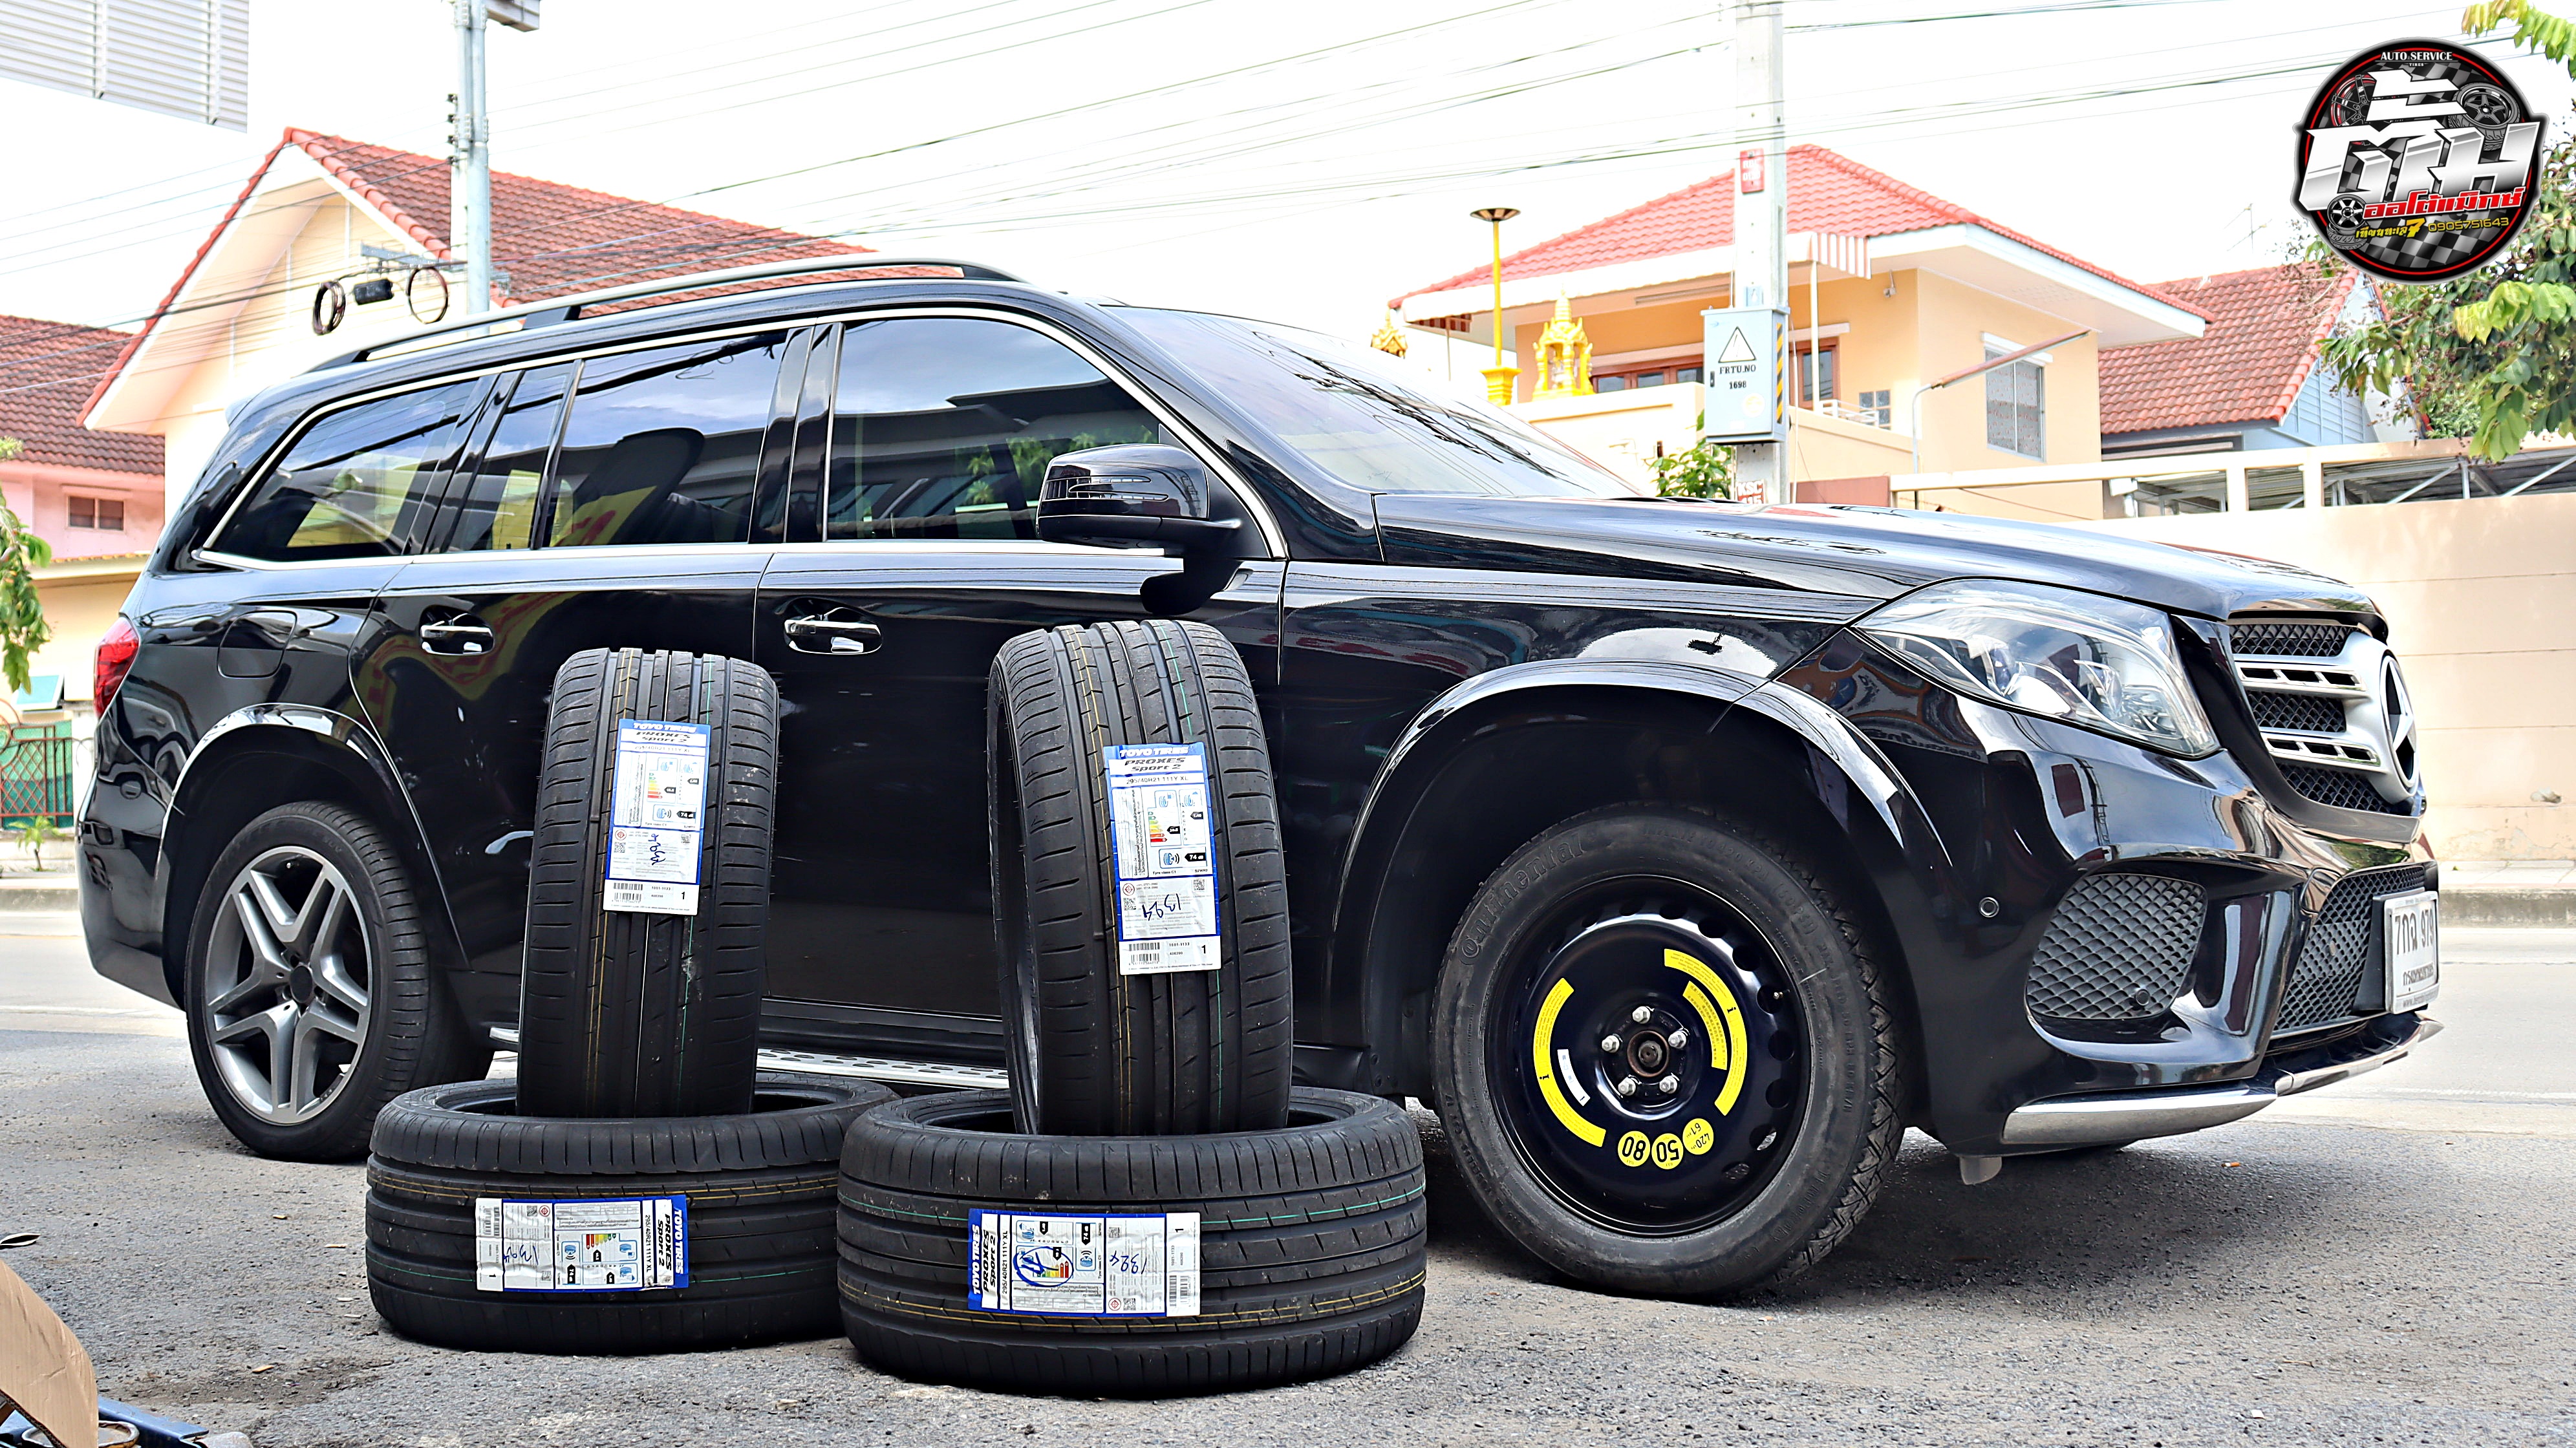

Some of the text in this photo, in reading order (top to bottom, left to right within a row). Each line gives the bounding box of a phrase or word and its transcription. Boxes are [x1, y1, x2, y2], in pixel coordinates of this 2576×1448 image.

[1729, 380, 1746, 389] 1698
[1737, 481, 1763, 496] KSC
[1119, 747, 1189, 758] TOYO TIRES
[1124, 757, 1186, 765] PROXES
[681, 891, 685, 900] 1
[2421, 909, 2434, 948] 979
[1201, 944, 1206, 953] 1
[1691, 1123, 1701, 1134] 61
[1696, 1133, 1710, 1148] 420
[1622, 1136, 1646, 1160] 80
[1657, 1140, 1679, 1162] 50
[1002, 1230, 1008, 1239] XL
[673, 1209, 683, 1274] TOYO TIRES
[972, 1225, 980, 1259] TIRES
[989, 1235, 996, 1246] 2
[658, 1257, 665, 1266] 2
